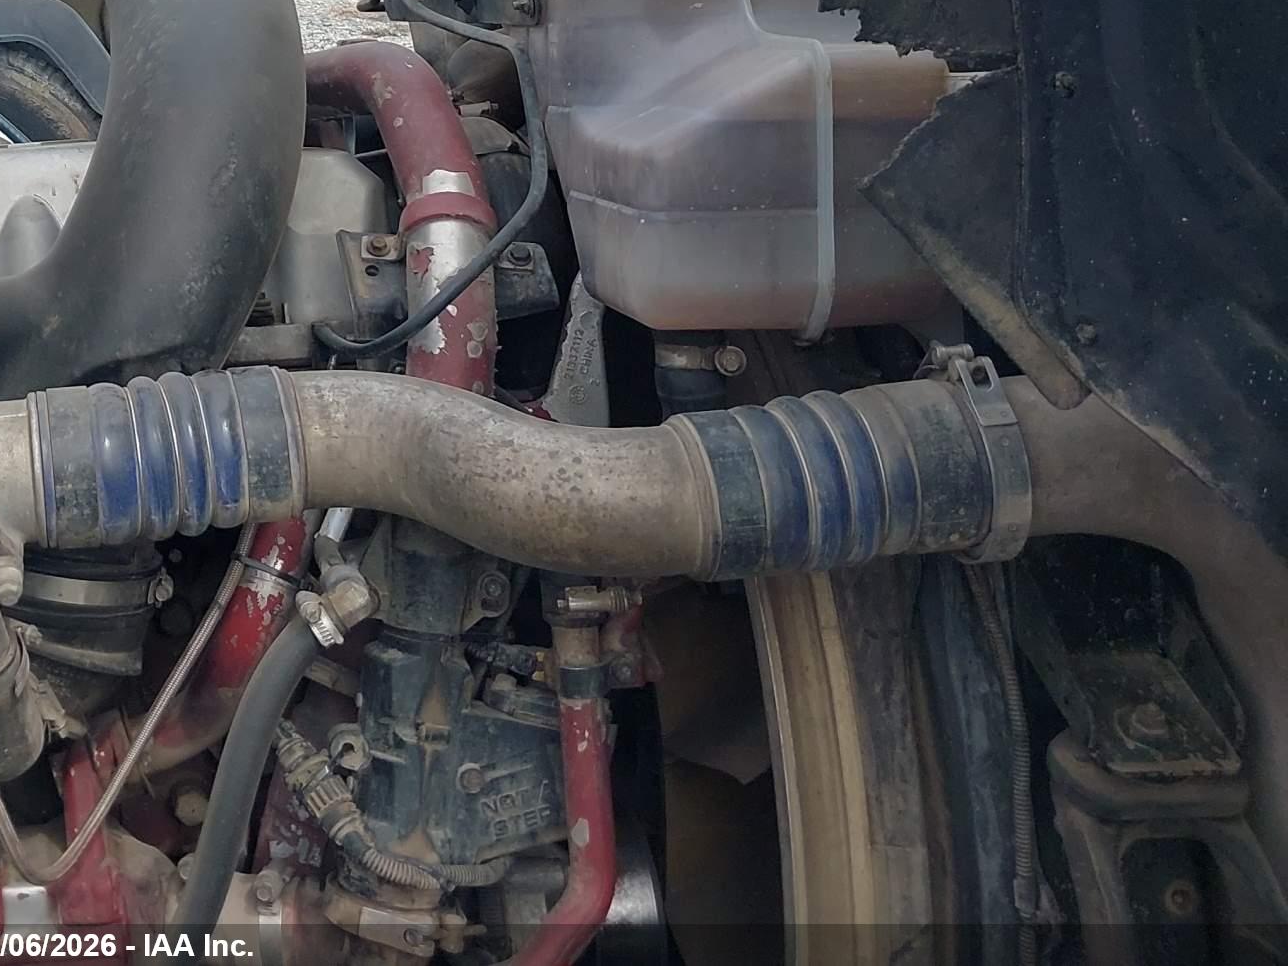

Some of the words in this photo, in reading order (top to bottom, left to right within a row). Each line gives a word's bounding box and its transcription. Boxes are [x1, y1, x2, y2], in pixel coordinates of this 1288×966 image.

[580, 337, 597, 375] CHINA
[479, 786, 530, 818] NOT
[492, 804, 552, 841] STEP
